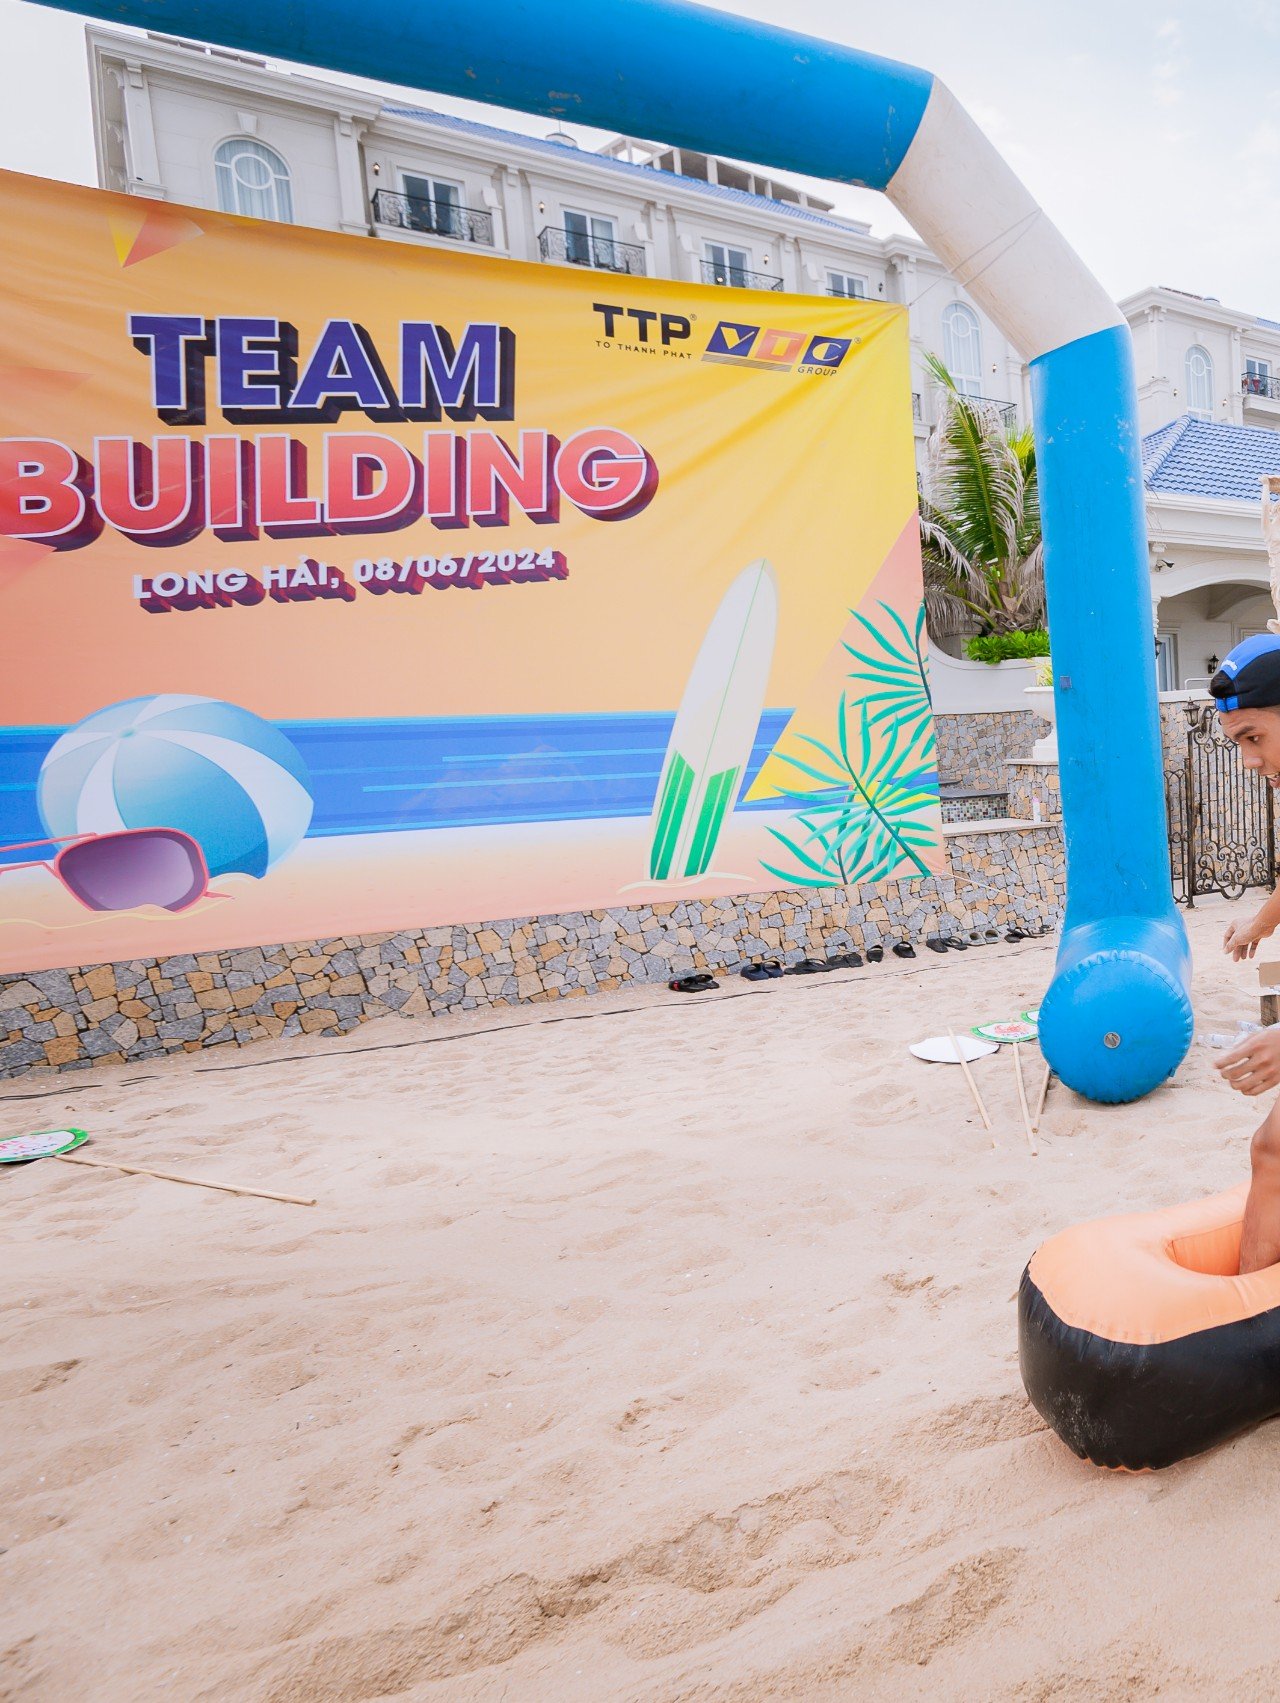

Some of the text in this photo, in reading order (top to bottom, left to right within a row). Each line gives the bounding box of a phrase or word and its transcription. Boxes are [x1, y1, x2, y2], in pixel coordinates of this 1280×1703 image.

[593, 302, 691, 346] TTP
[715, 324, 845, 363] VTC
[127, 312, 510, 420] TEAM
[596, 340, 692, 360] TO THANH PHAT
[797, 366, 837, 377] GROUP
[0, 426, 654, 546] BUILDING
[132, 567, 252, 602] LONG
[353, 546, 559, 586] 08/06/2024
